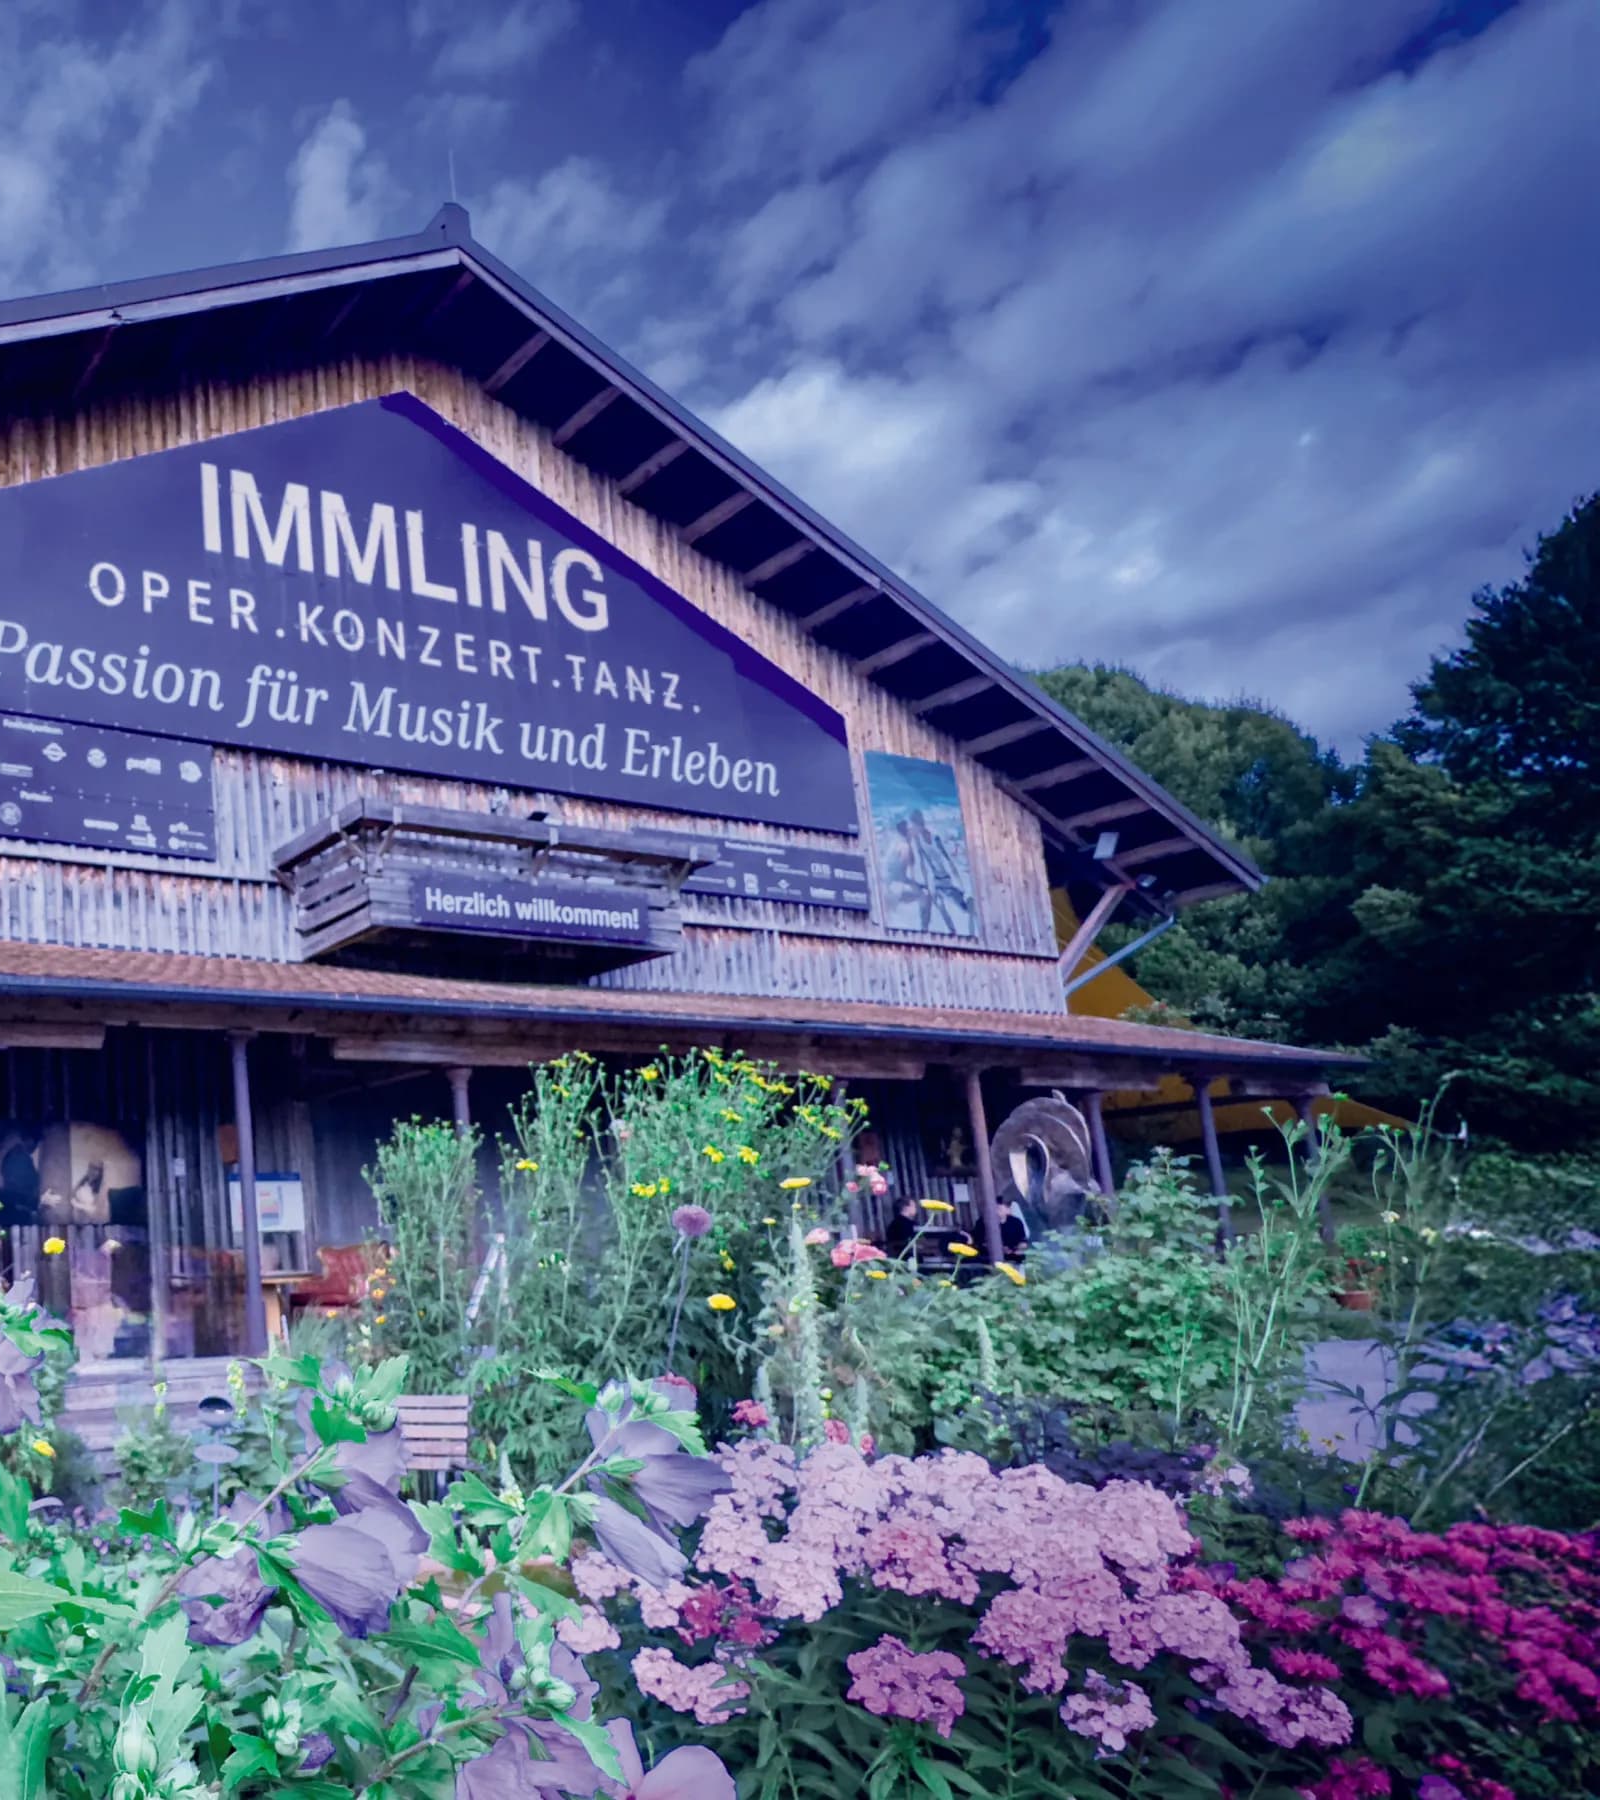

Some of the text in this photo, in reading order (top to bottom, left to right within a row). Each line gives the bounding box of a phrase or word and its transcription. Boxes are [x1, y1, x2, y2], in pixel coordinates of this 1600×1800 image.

[200, 462, 610, 632] IMMLING
[236, 664, 329, 729] für
[342, 680, 504, 755] Musik
[519, 722, 608, 771] und
[620, 727, 781, 797] Erleben
[425, 886, 640, 930] Herzlich willkommen!
